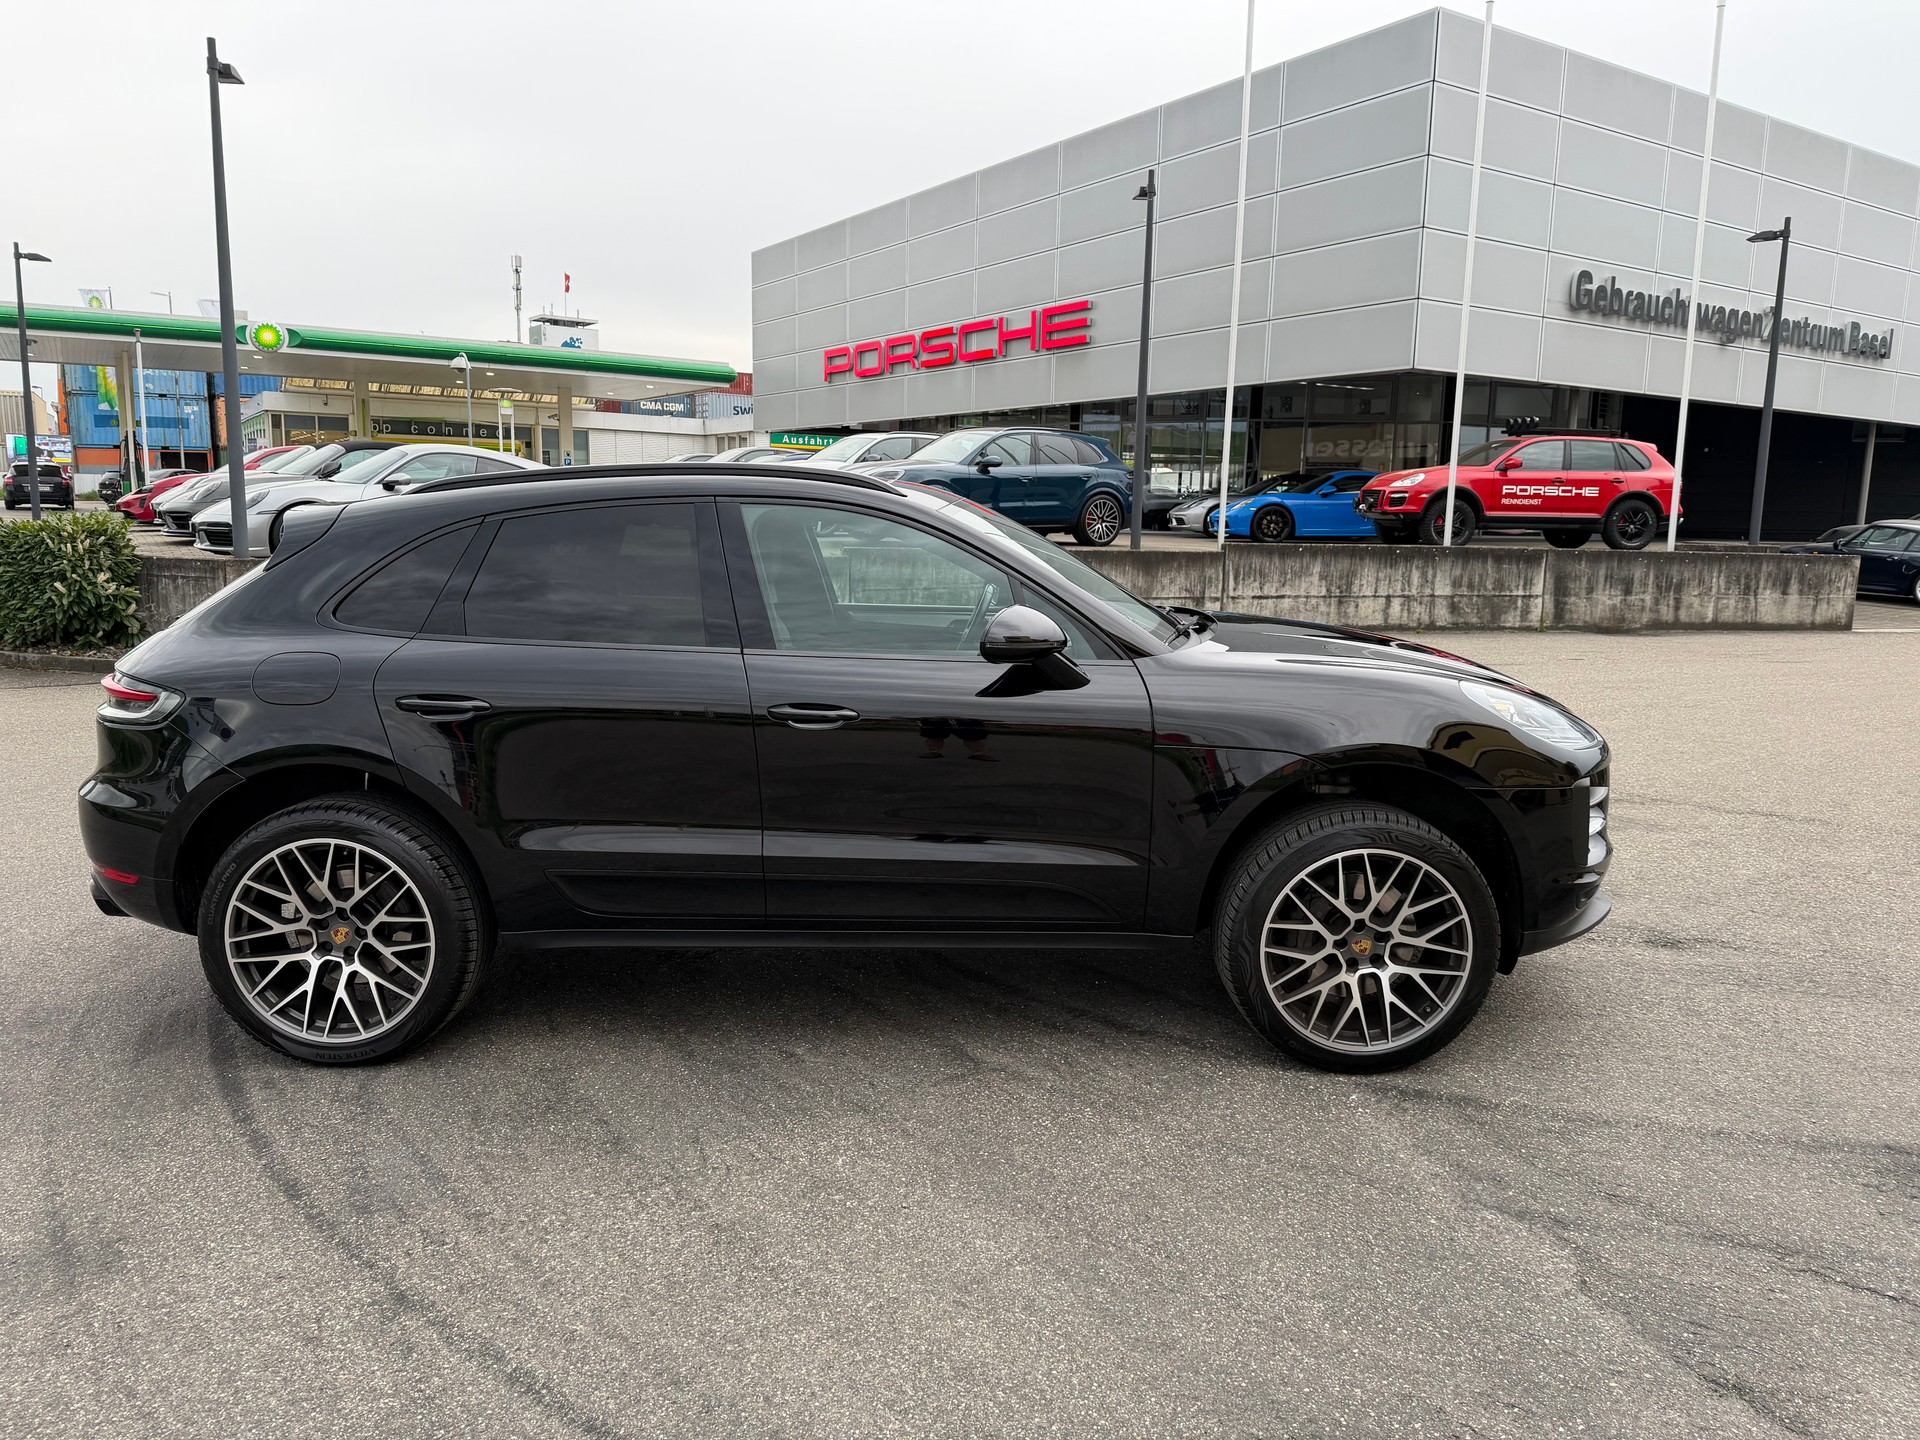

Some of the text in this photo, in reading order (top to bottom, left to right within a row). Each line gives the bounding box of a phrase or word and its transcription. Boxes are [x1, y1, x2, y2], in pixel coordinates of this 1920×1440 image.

[823, 299, 1093, 383] PORSCHE
[1844, 321, 1894, 360] Basel
[640, 401, 685, 412] CMA CGM
[371, 420, 392, 434] bp
[782, 434, 834, 446] Ausfahrt
[1502, 485, 1600, 497] PORSCHE
[1501, 498, 1543, 506] RENNDIENST
[221, 862, 237, 882] PRO
